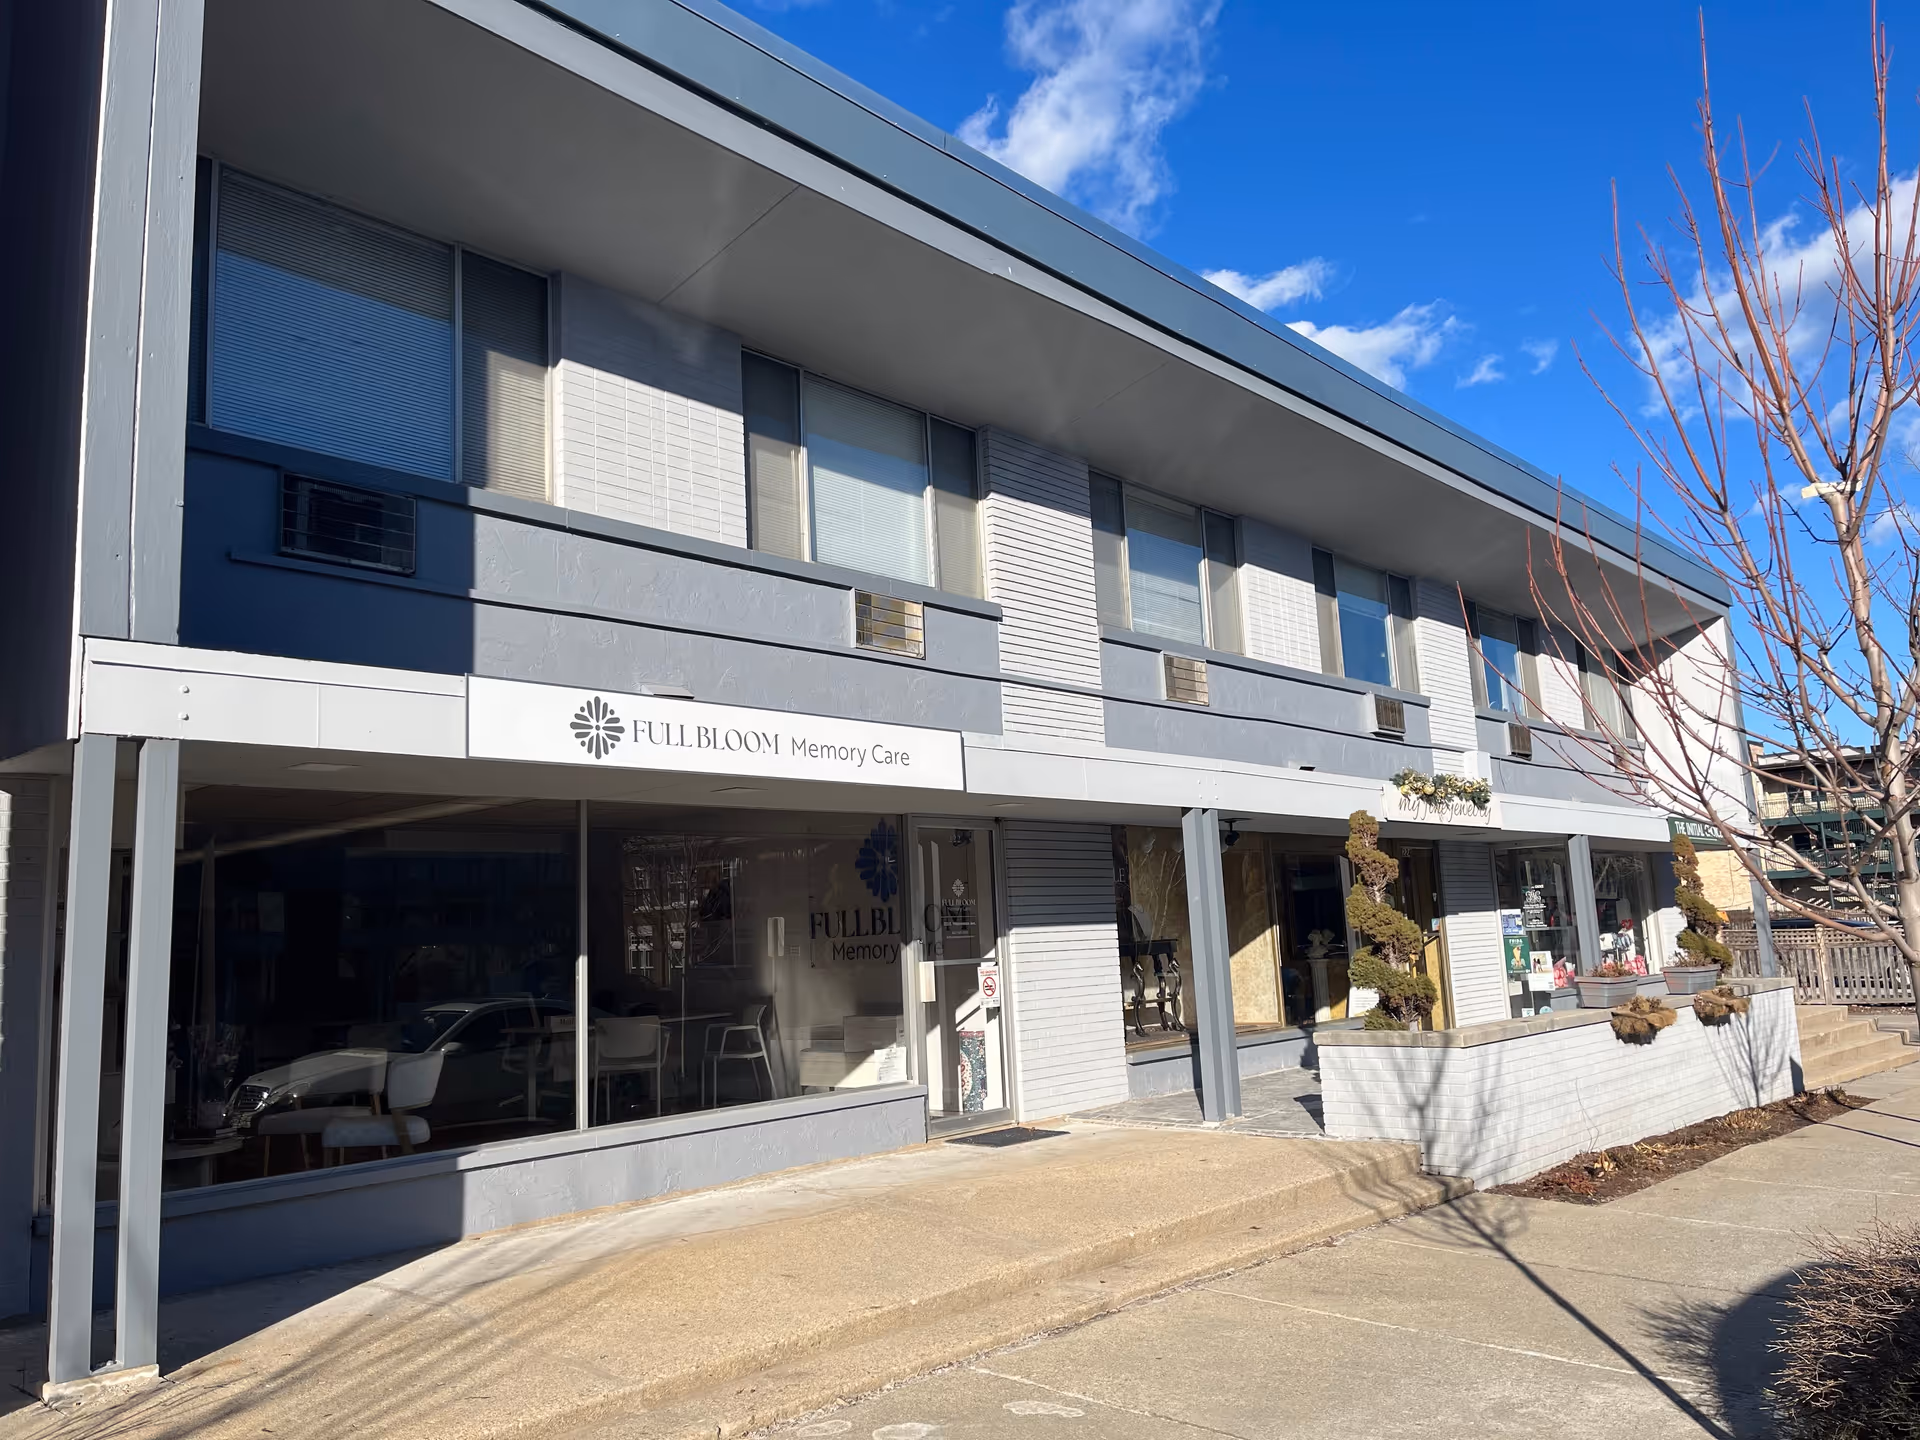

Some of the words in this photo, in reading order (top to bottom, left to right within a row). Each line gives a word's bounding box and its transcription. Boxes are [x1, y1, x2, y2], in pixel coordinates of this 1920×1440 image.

[791, 735, 867, 768] Memory
[871, 744, 910, 767] Care
[1675, 821, 1686, 836] THE
[1686, 823, 1705, 837] INITIAL
[832, 941, 900, 964] Memory
